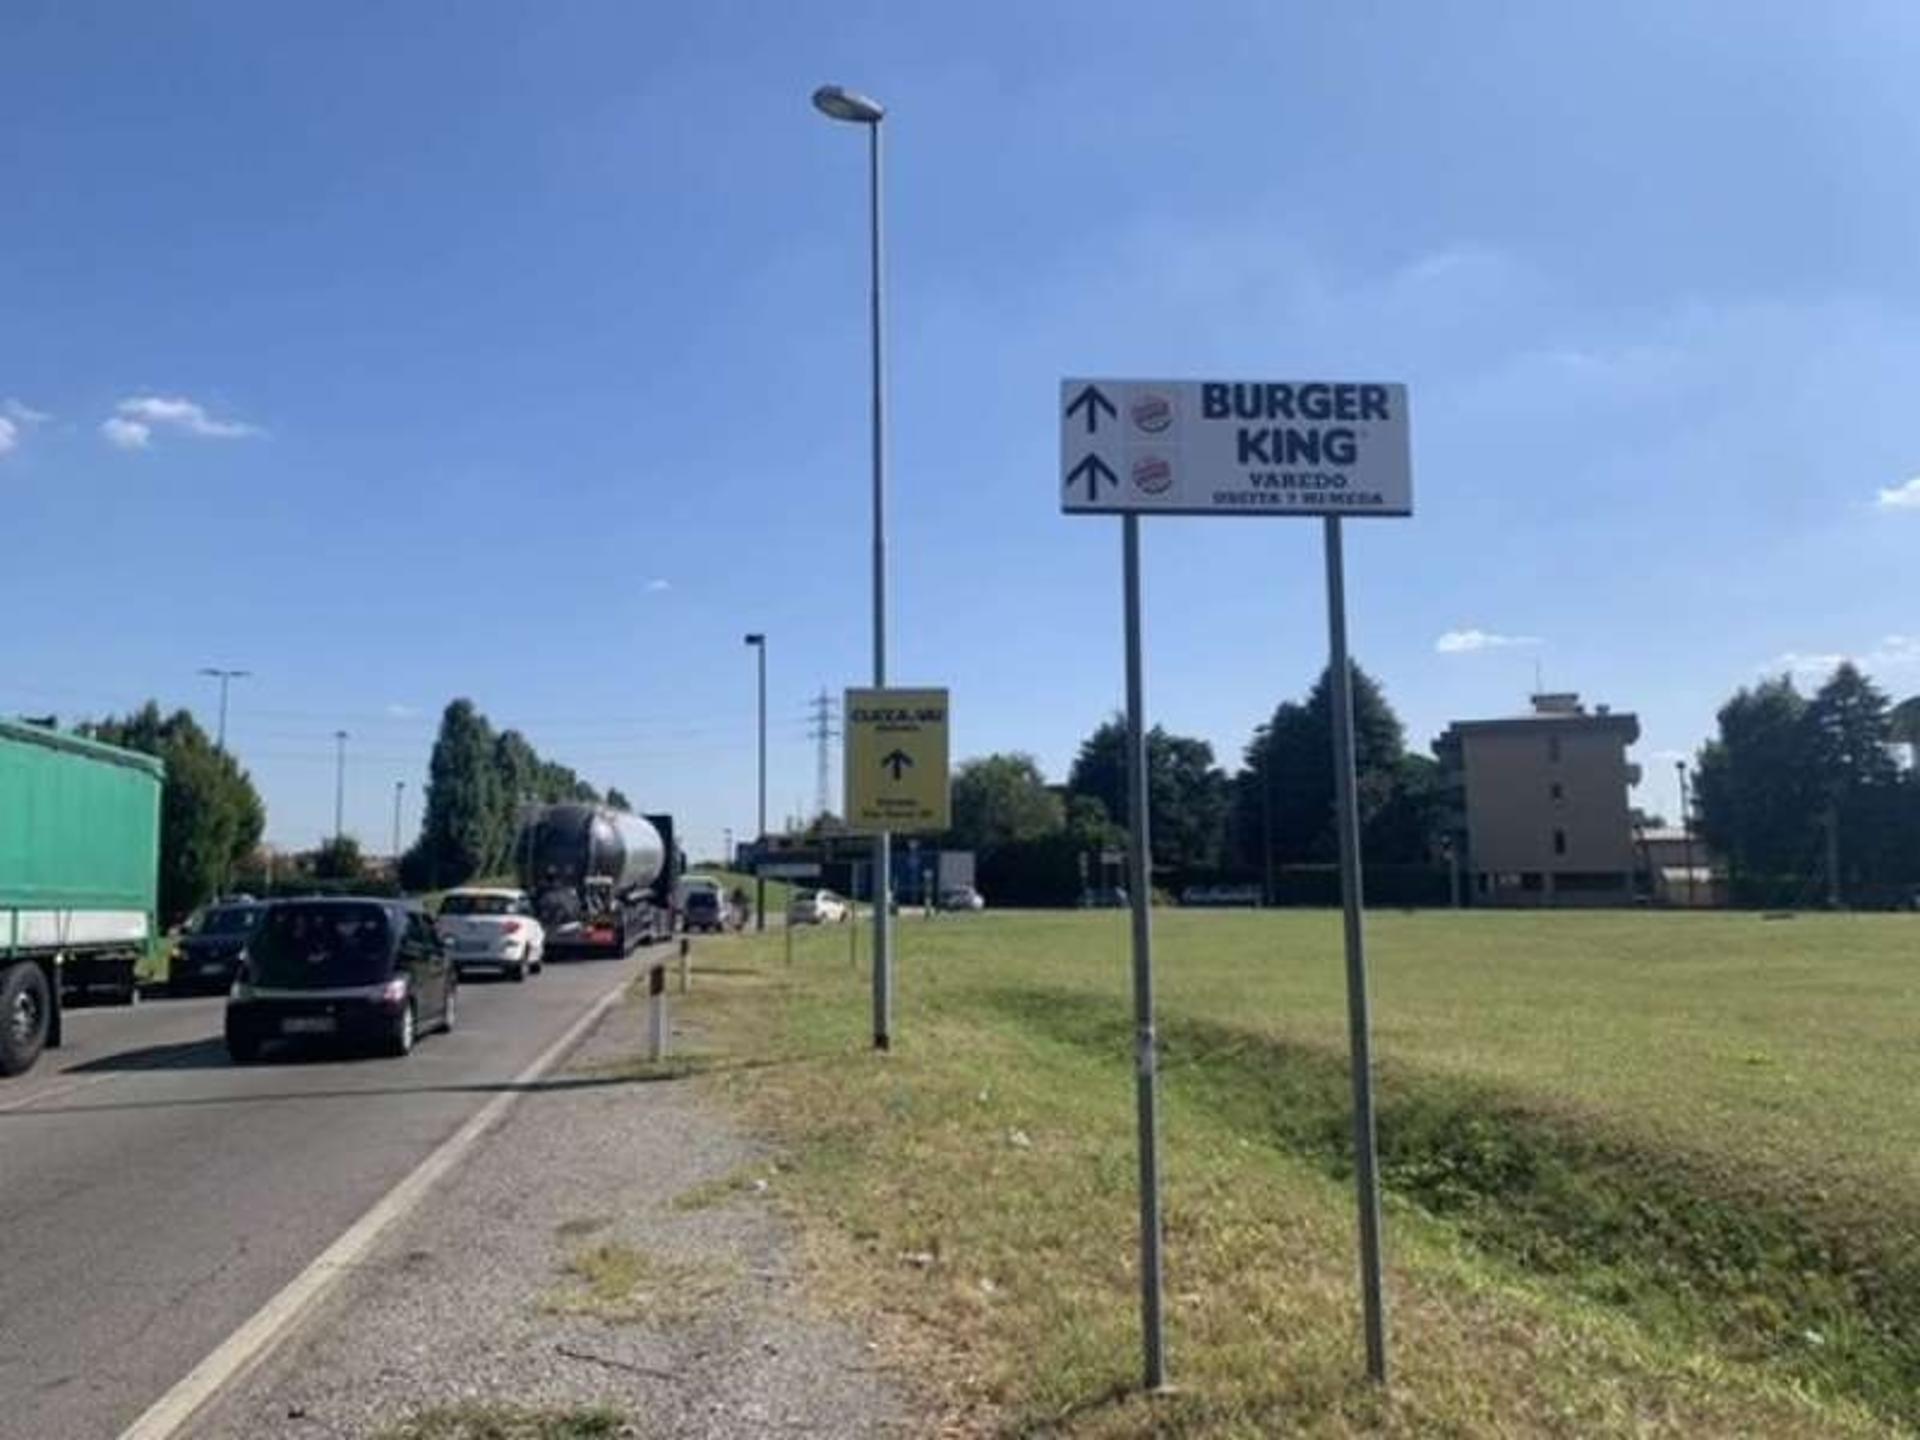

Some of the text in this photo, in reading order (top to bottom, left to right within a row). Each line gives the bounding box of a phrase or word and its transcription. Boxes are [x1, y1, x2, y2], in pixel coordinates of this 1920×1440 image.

[1202, 382, 1389, 421] BURGER
[1237, 428, 1357, 465] KING
[1250, 472, 1347, 489] VAREDO
